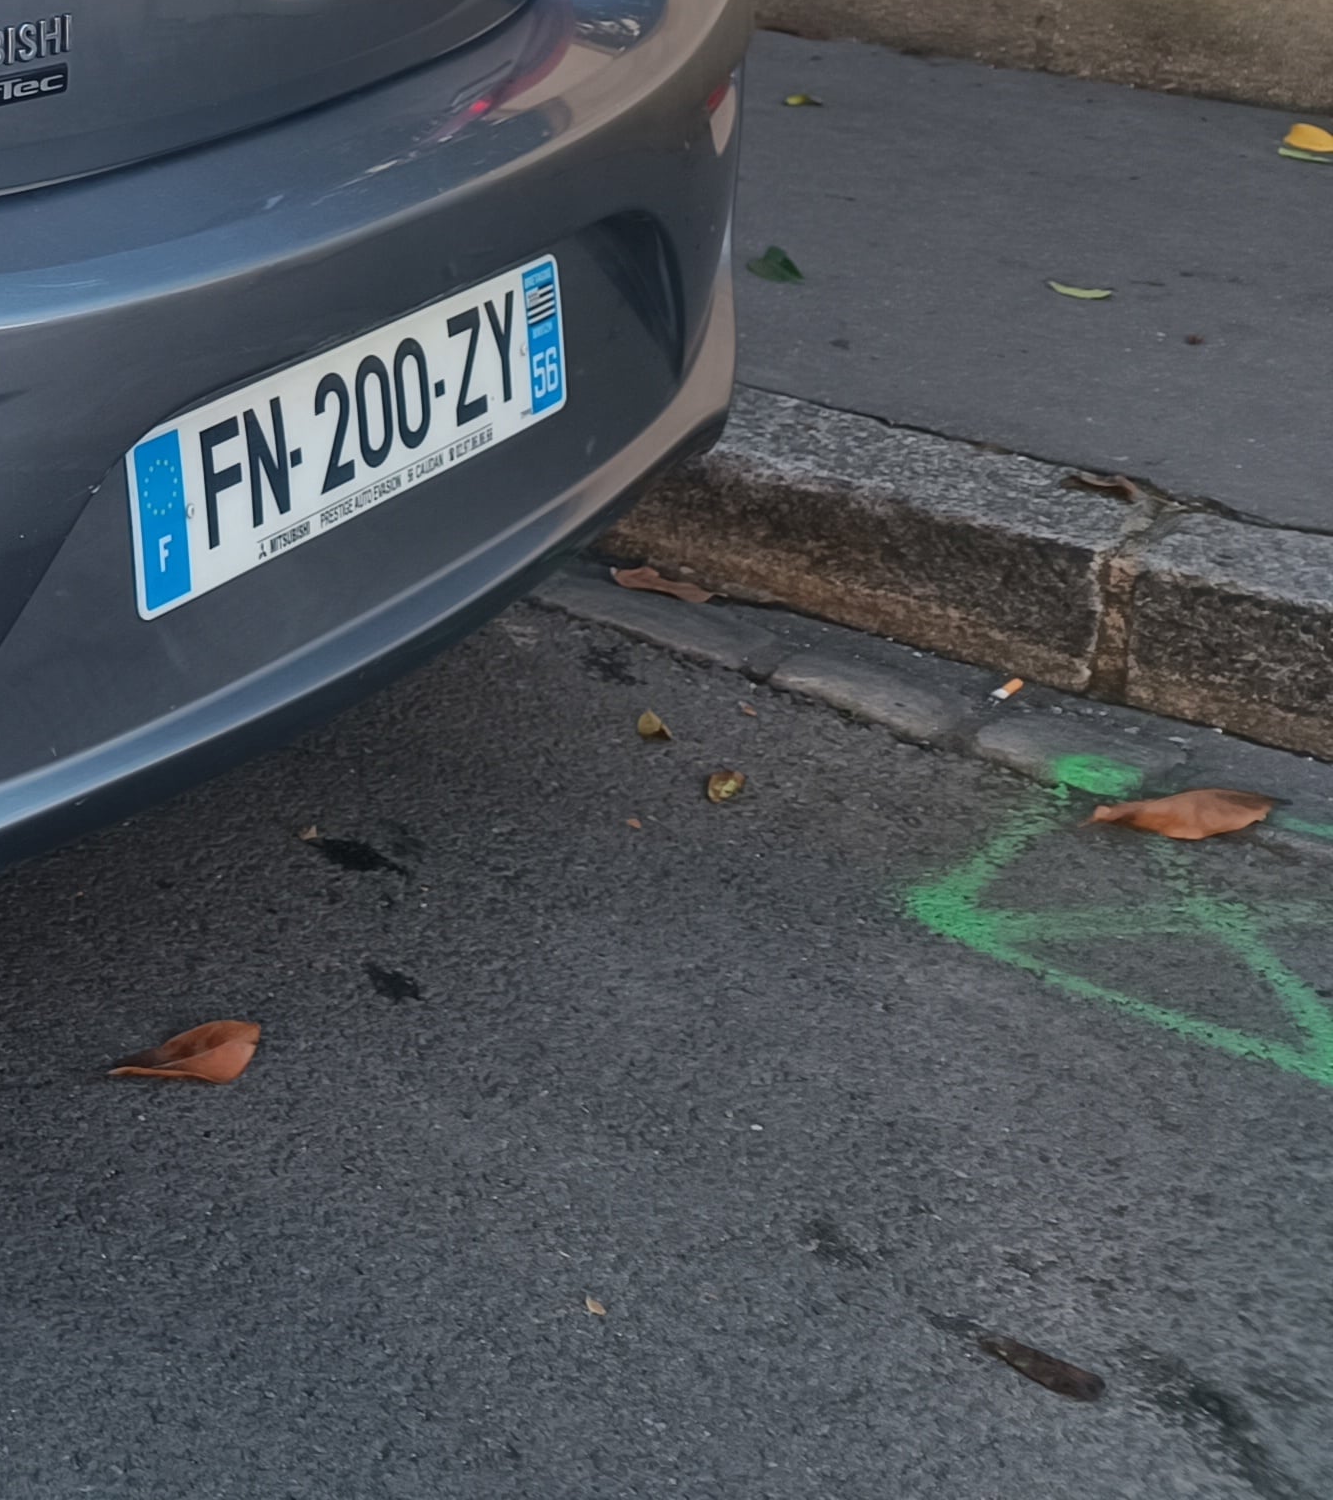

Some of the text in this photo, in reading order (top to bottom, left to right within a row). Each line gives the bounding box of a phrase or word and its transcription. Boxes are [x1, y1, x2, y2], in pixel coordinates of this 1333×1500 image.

[532, 346, 558, 399] 56
[158, 534, 173, 573] F
[269, 520, 311, 554] MITSUBISHI
